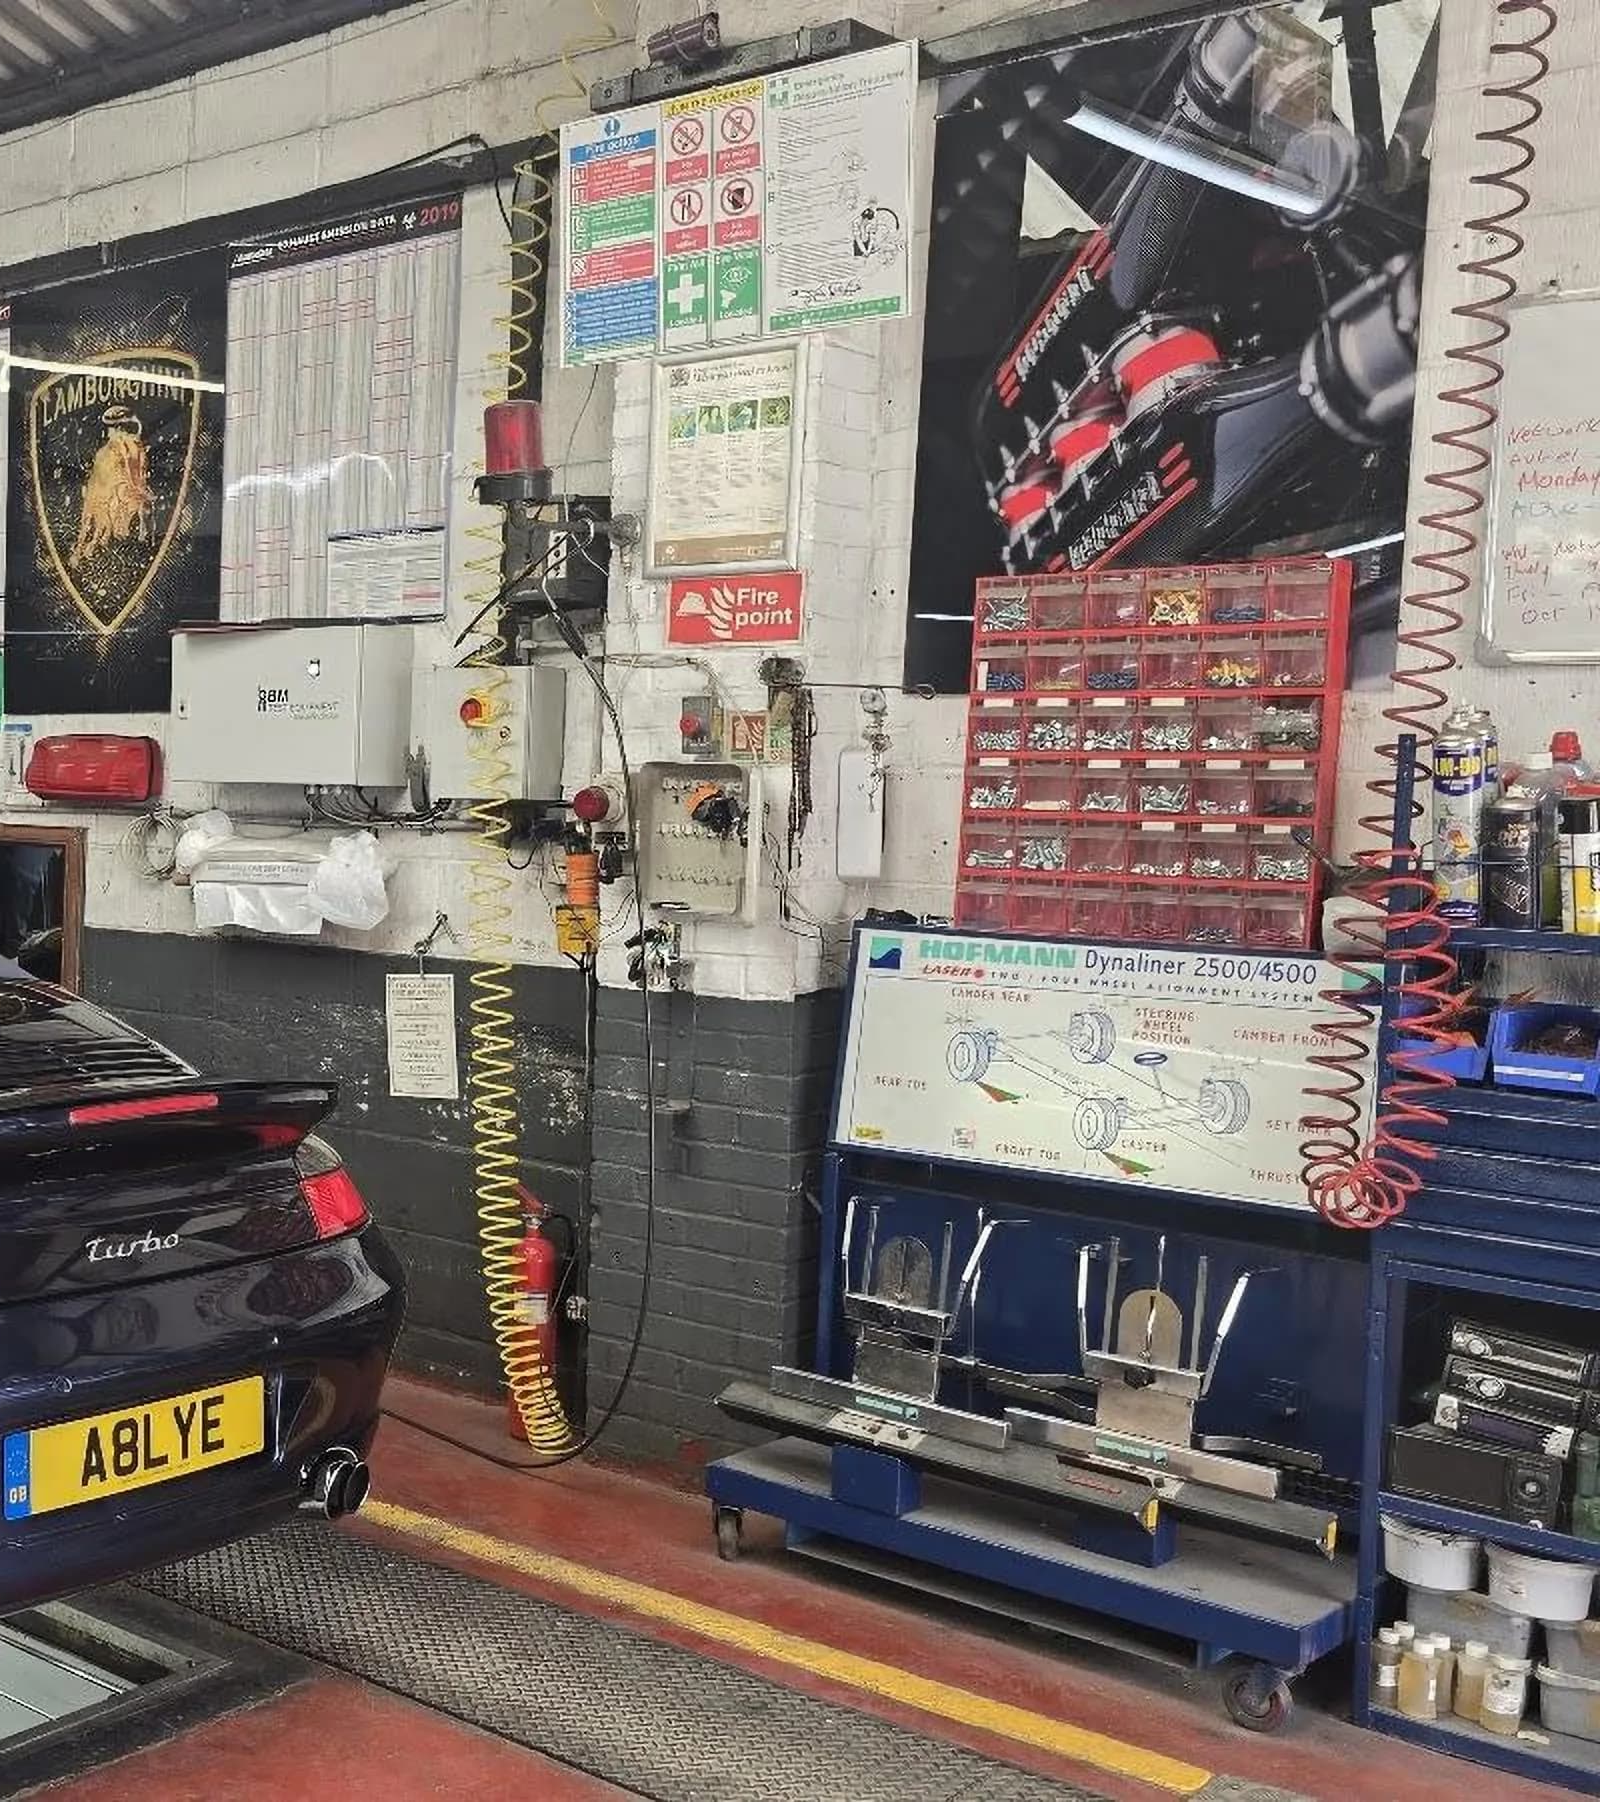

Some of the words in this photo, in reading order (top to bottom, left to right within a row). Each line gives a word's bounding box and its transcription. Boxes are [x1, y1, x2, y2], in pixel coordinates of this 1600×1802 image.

[419, 201, 459, 226] 2019
[736, 586, 780, 607] Fire
[734, 606, 794, 631] point
[918, 939, 1077, 969] HOFMANN
[1084, 948, 1186, 981] Dynaliner
[1193, 956, 1318, 985] 2500/4500
[1131, 1031, 1192, 1045] POSITION
[1232, 1028, 1286, 1044] CAMBER
[1292, 1032, 1338, 1048] FRONT
[85, 1229, 179, 1262] Turbo
[81, 1394, 226, 1488] A8LYE
[8, 1484, 28, 1504] GB
